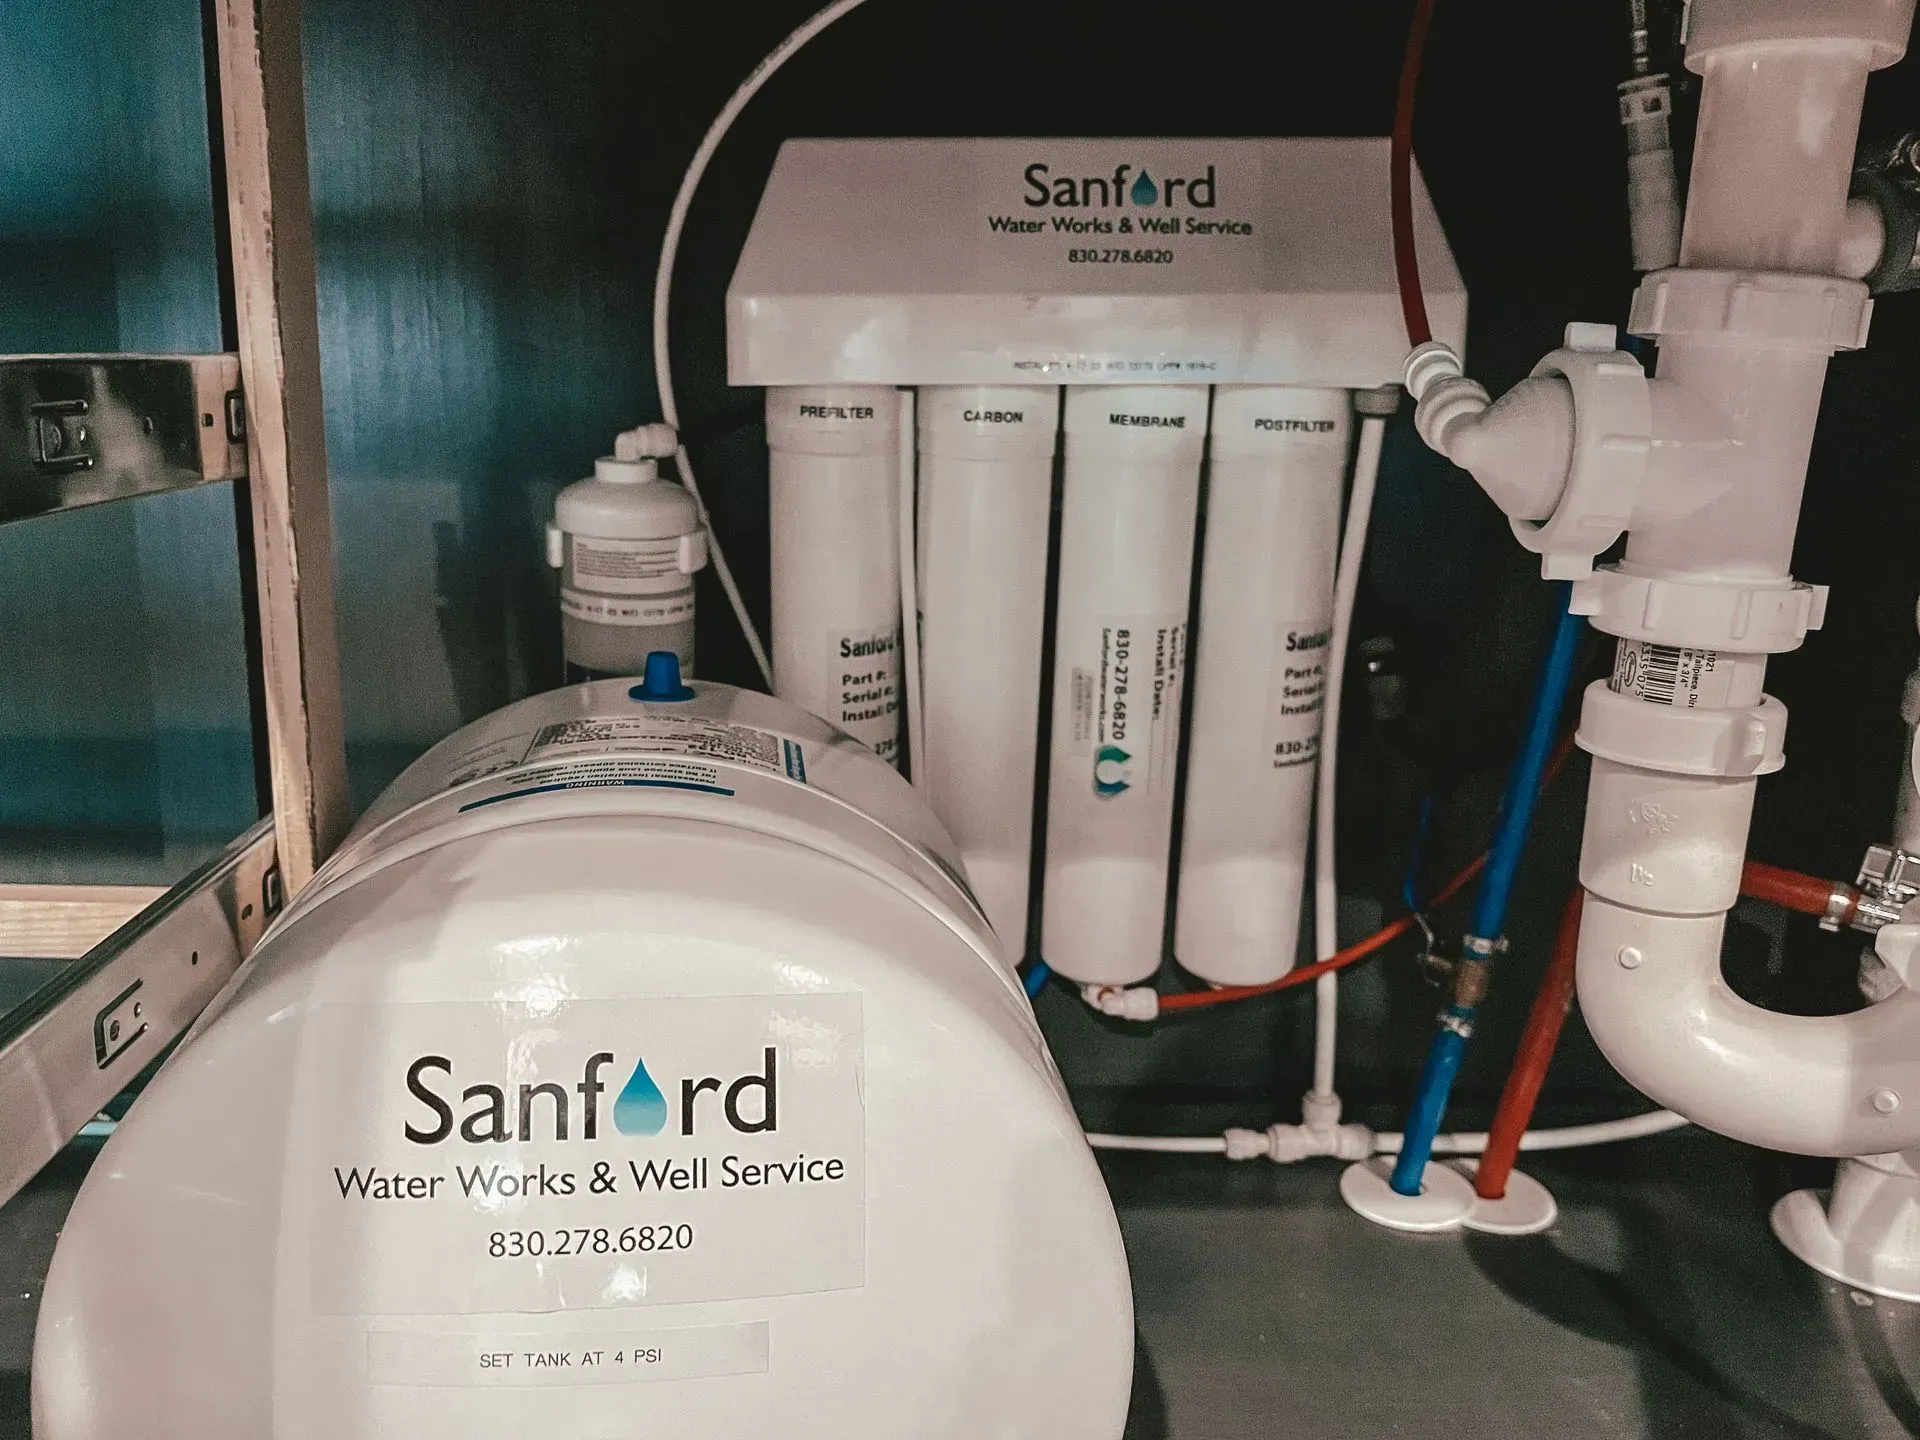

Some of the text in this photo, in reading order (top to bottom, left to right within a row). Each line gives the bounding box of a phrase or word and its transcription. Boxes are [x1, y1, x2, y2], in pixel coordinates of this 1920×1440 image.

[1023, 163, 1216, 208] Sanford
[988, 216, 1253, 236] Water Works & Well Service
[1067, 249, 1174, 264] 830.278.6820
[800, 405, 874, 419] PREFILTER
[963, 410, 1024, 423] CARBON
[1108, 413, 1185, 429] MEMBRANE
[1254, 418, 1335, 432] POSTFILTER
[1155, 628, 1166, 676] Install
[842, 672, 873, 686] Part
[1112, 629, 1130, 740] 830-278-6820
[842, 687, 882, 704] Serial
[405, 1047, 777, 1144] Sanford
[334, 1153, 845, 1200] Water Works & Well Service
[489, 1223, 694, 1257] 830.278.6820
[479, 1348, 662, 1368] SET TANK AT 4 PSI
